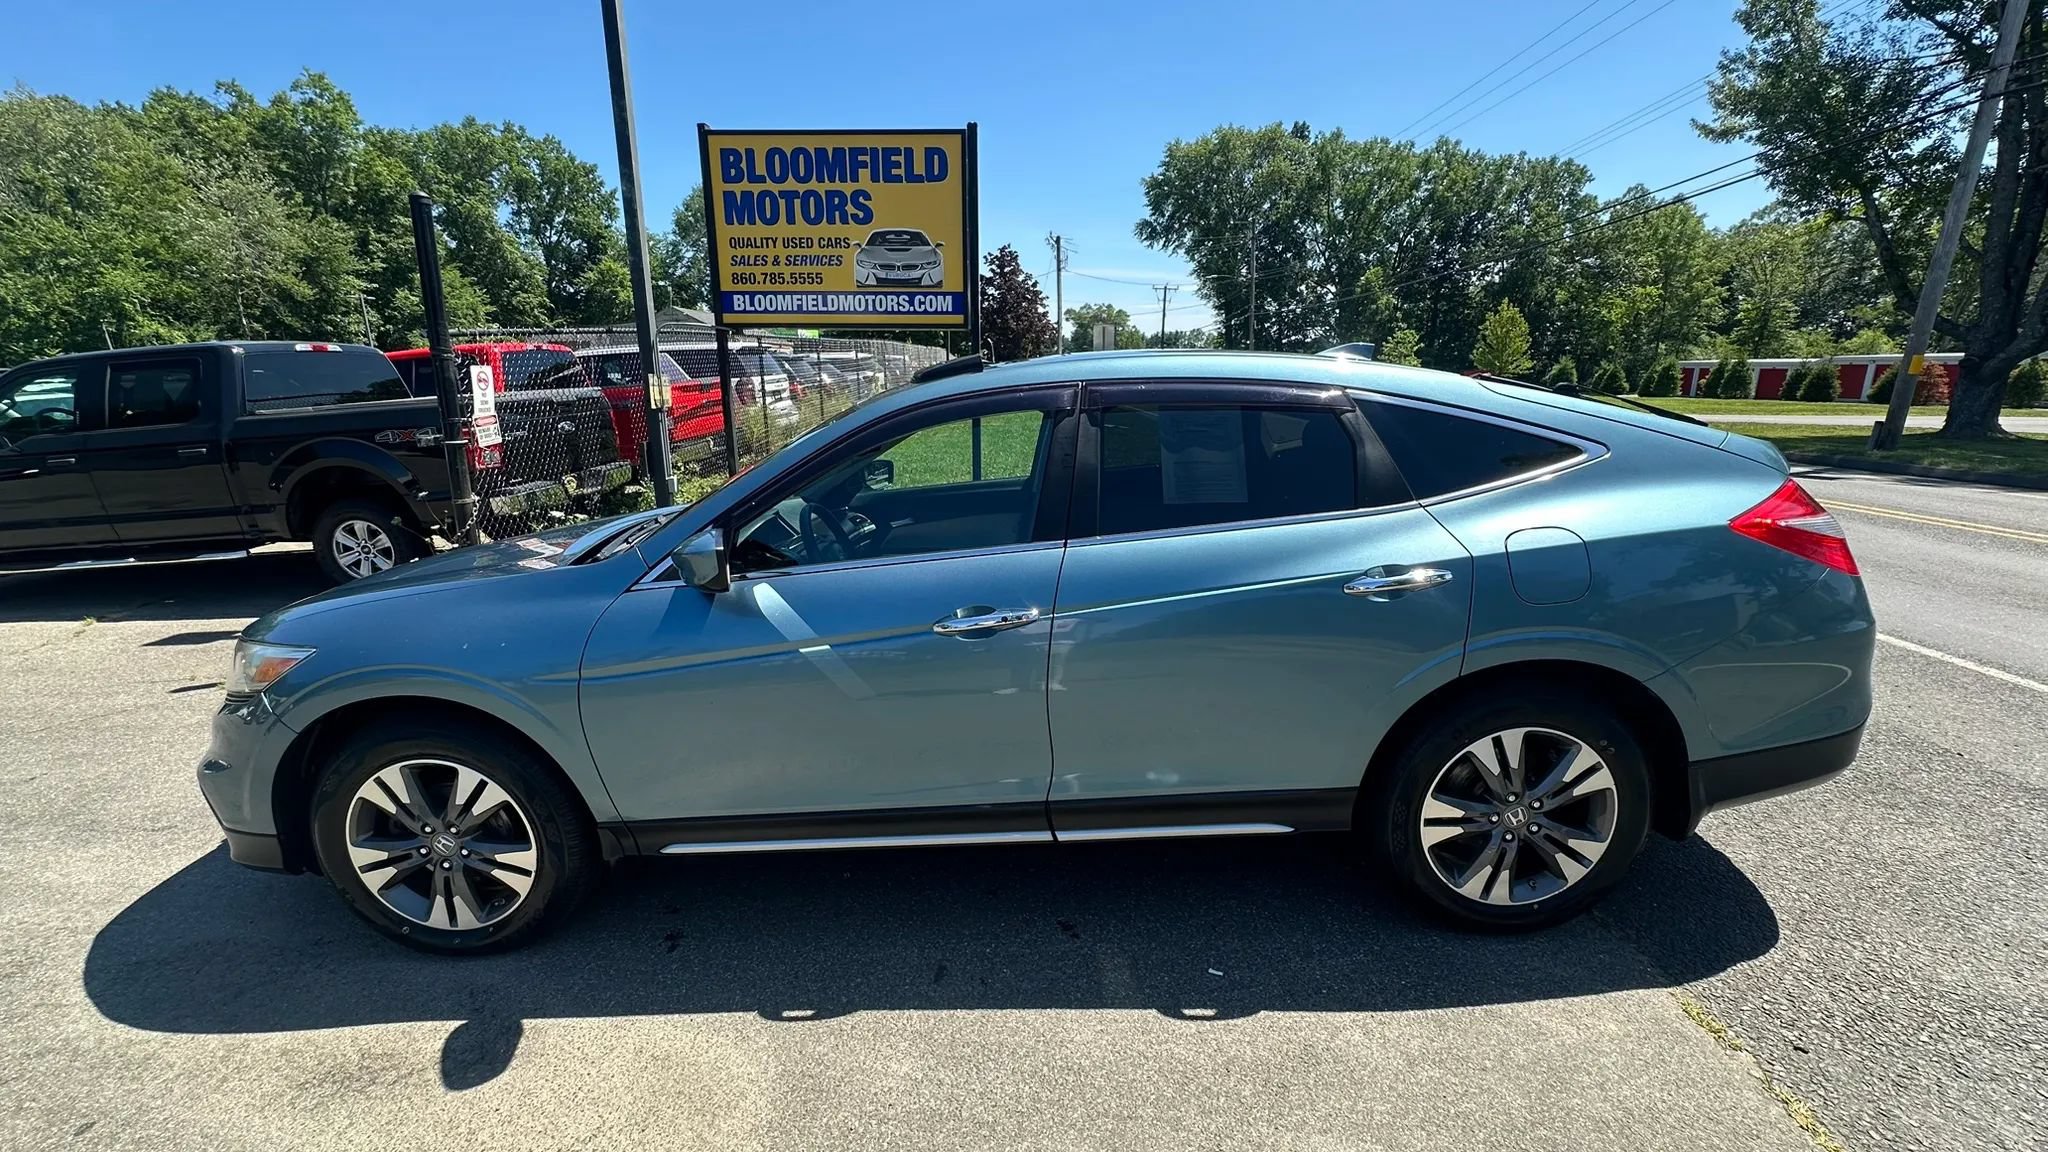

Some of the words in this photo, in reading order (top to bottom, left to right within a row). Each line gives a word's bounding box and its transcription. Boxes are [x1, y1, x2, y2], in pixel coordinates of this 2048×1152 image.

[720, 147, 949, 184] BLOOMFIELD
[723, 189, 874, 226] MOTORS
[729, 236, 778, 250] QUALITY
[782, 237, 814, 249] USED
[818, 237, 850, 249] CARS
[730, 254, 768, 267] SALES
[771, 255, 781, 267] &
[784, 254, 843, 267] SERVICES
[731, 272, 824, 285] 860.785.5555
[733, 294, 953, 312] BLOOMFIELDMOTORS.COM
